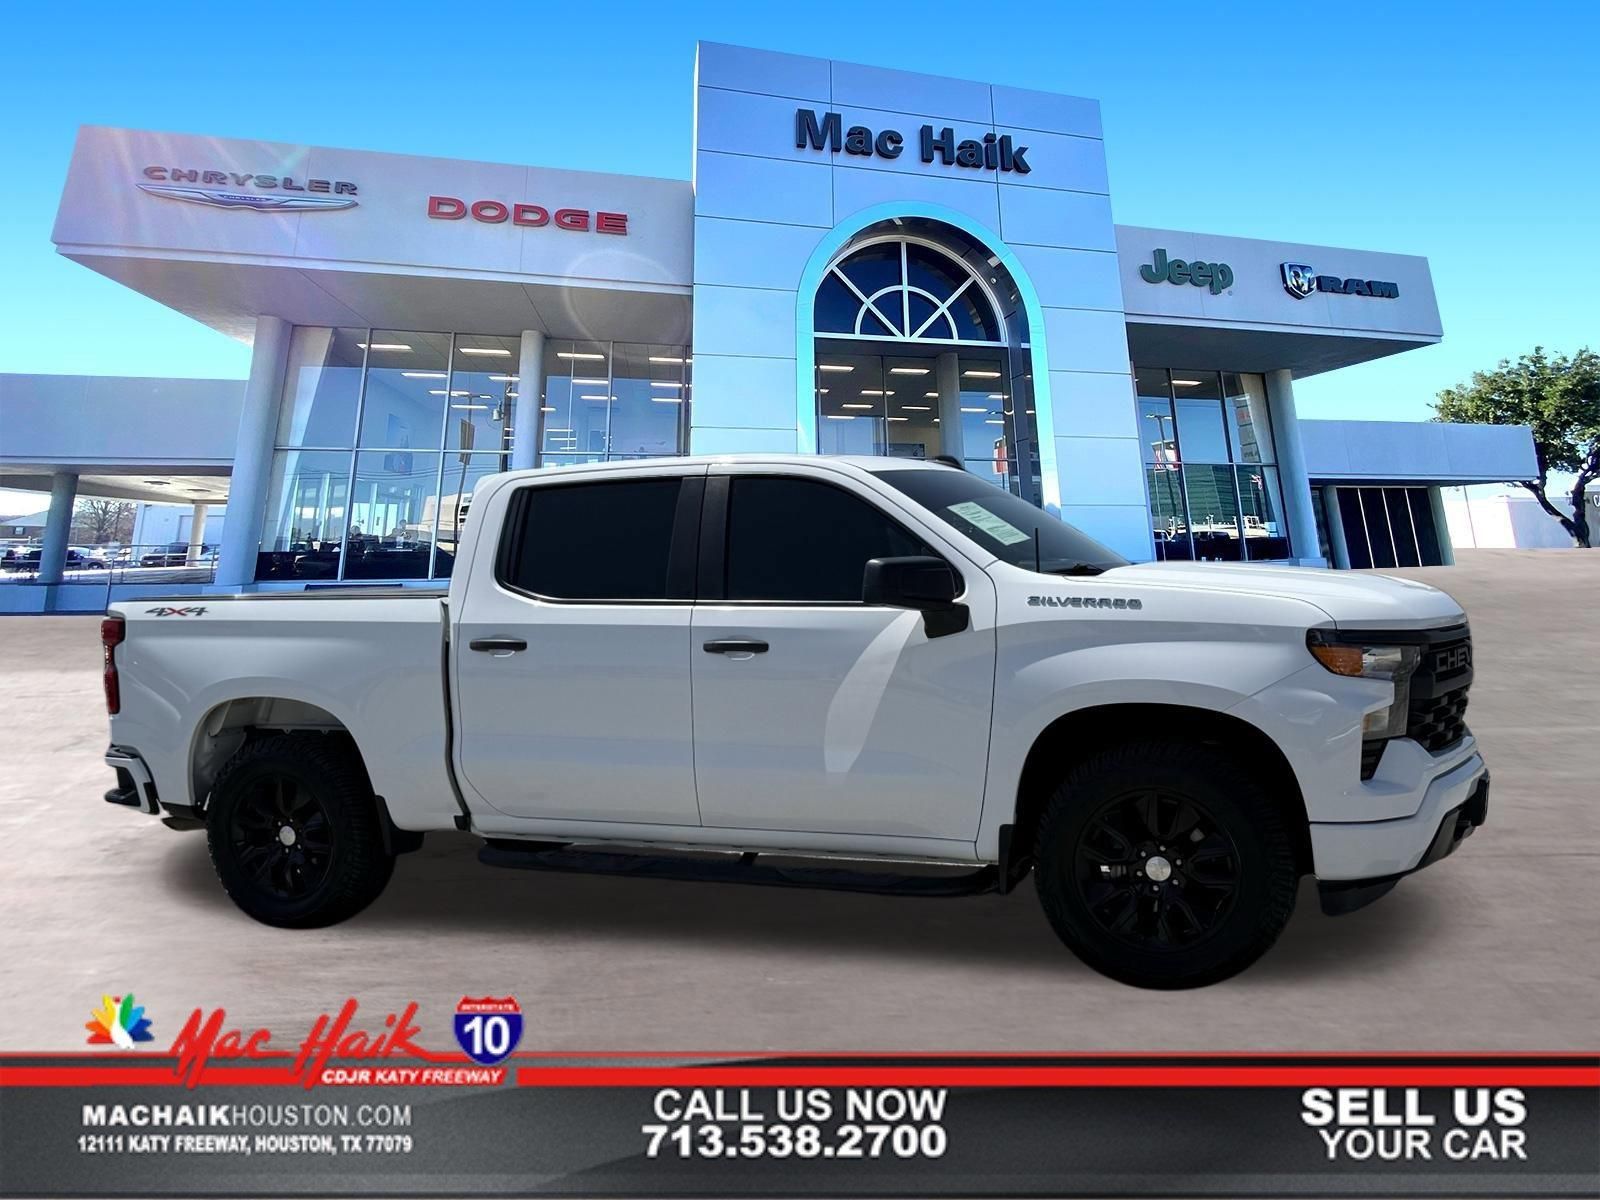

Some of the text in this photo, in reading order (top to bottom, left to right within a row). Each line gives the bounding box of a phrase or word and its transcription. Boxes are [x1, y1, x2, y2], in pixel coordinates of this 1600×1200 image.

[796, 108, 1032, 174] Mac Haik
[143, 166, 358, 196] CHRYSLER
[428, 196, 628, 236] DODGE
[1140, 248, 1234, 295] Jeep
[1316, 275, 1399, 299] RAM
[1027, 595, 1142, 610] SILVERADO
